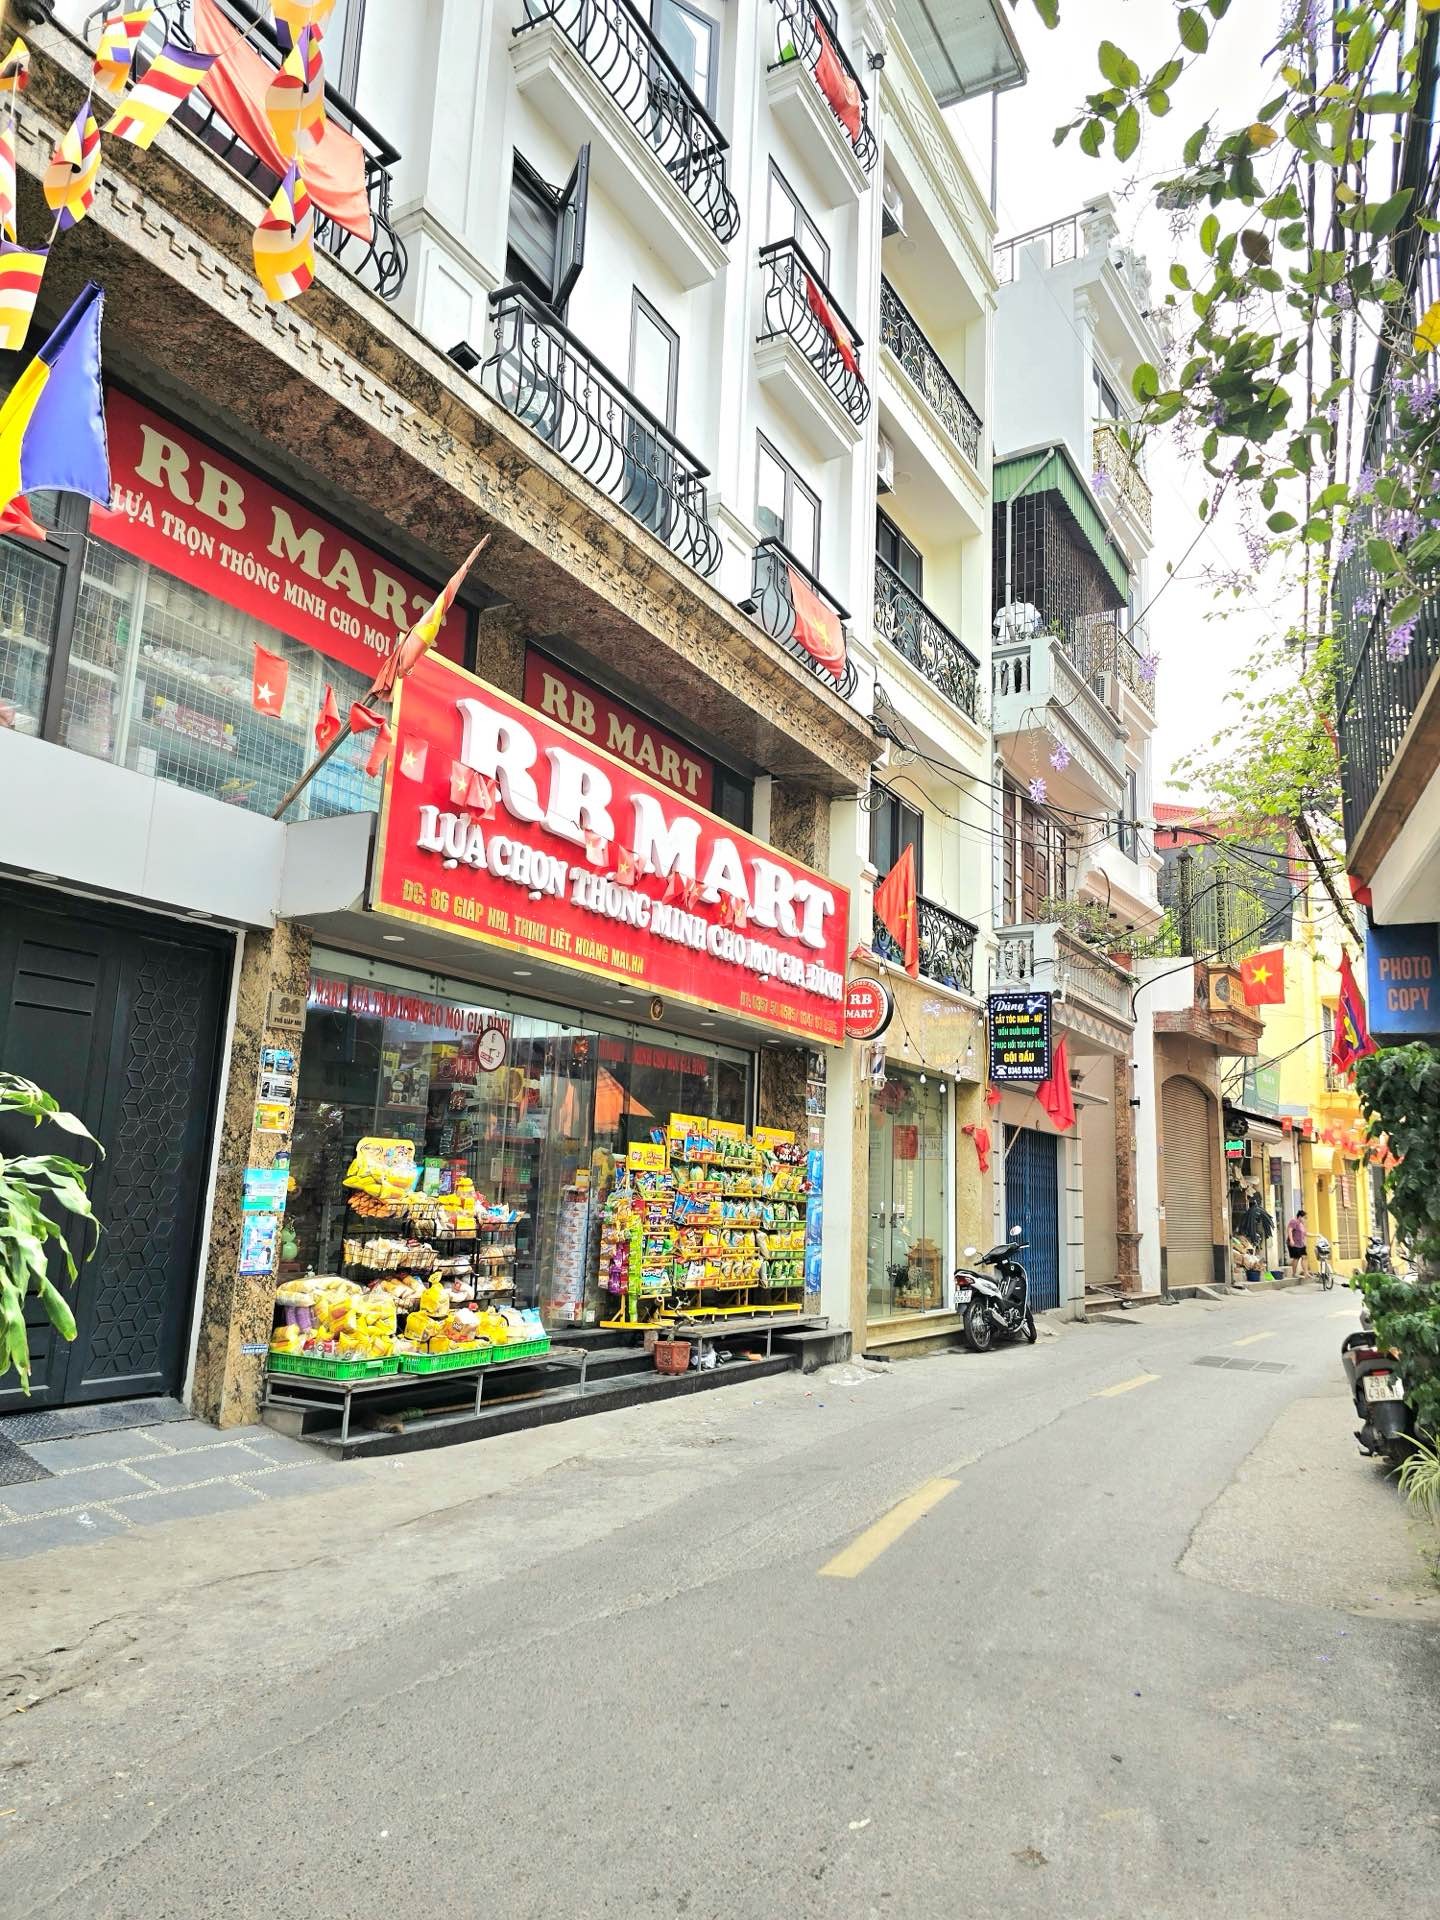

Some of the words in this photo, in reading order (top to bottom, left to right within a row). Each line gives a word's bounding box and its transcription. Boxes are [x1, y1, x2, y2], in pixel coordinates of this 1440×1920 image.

[134, 424, 247, 530] RB
[111, 483, 155, 527] LỰA
[161, 510, 215, 560] TRỌN
[220, 543, 280, 594] THÔNG
[284, 580, 327, 621] MINH
[330, 606, 361, 639] CHO
[364, 624, 391, 658] MỌI
[540, 673, 596, 735] RB
[606, 712, 702, 796] MART
[456, 698, 616, 851] RB
[630, 793, 835, 950] MART
[416, 805, 488, 870] LỰA
[487, 836, 569, 900] CHỌN
[569, 866, 651, 929] THÔNG
[650, 900, 708, 951] MINH
[707, 924, 747, 965] CHO
[744, 939, 778, 983] MỌI
[777, 952, 806, 987] GIA
[805, 960, 843, 1001] ĐÌNH
[453, 897, 483, 923] GIÁP
[514, 915, 547, 943] THỊNH
[575, 936, 608, 964] HOÀNG
[850, 993, 872, 1004] RB
[1378, 956, 1431, 980] PHOTO
[1387, 987, 1430, 1012] COPY
[846, 1009, 875, 1018] MART
